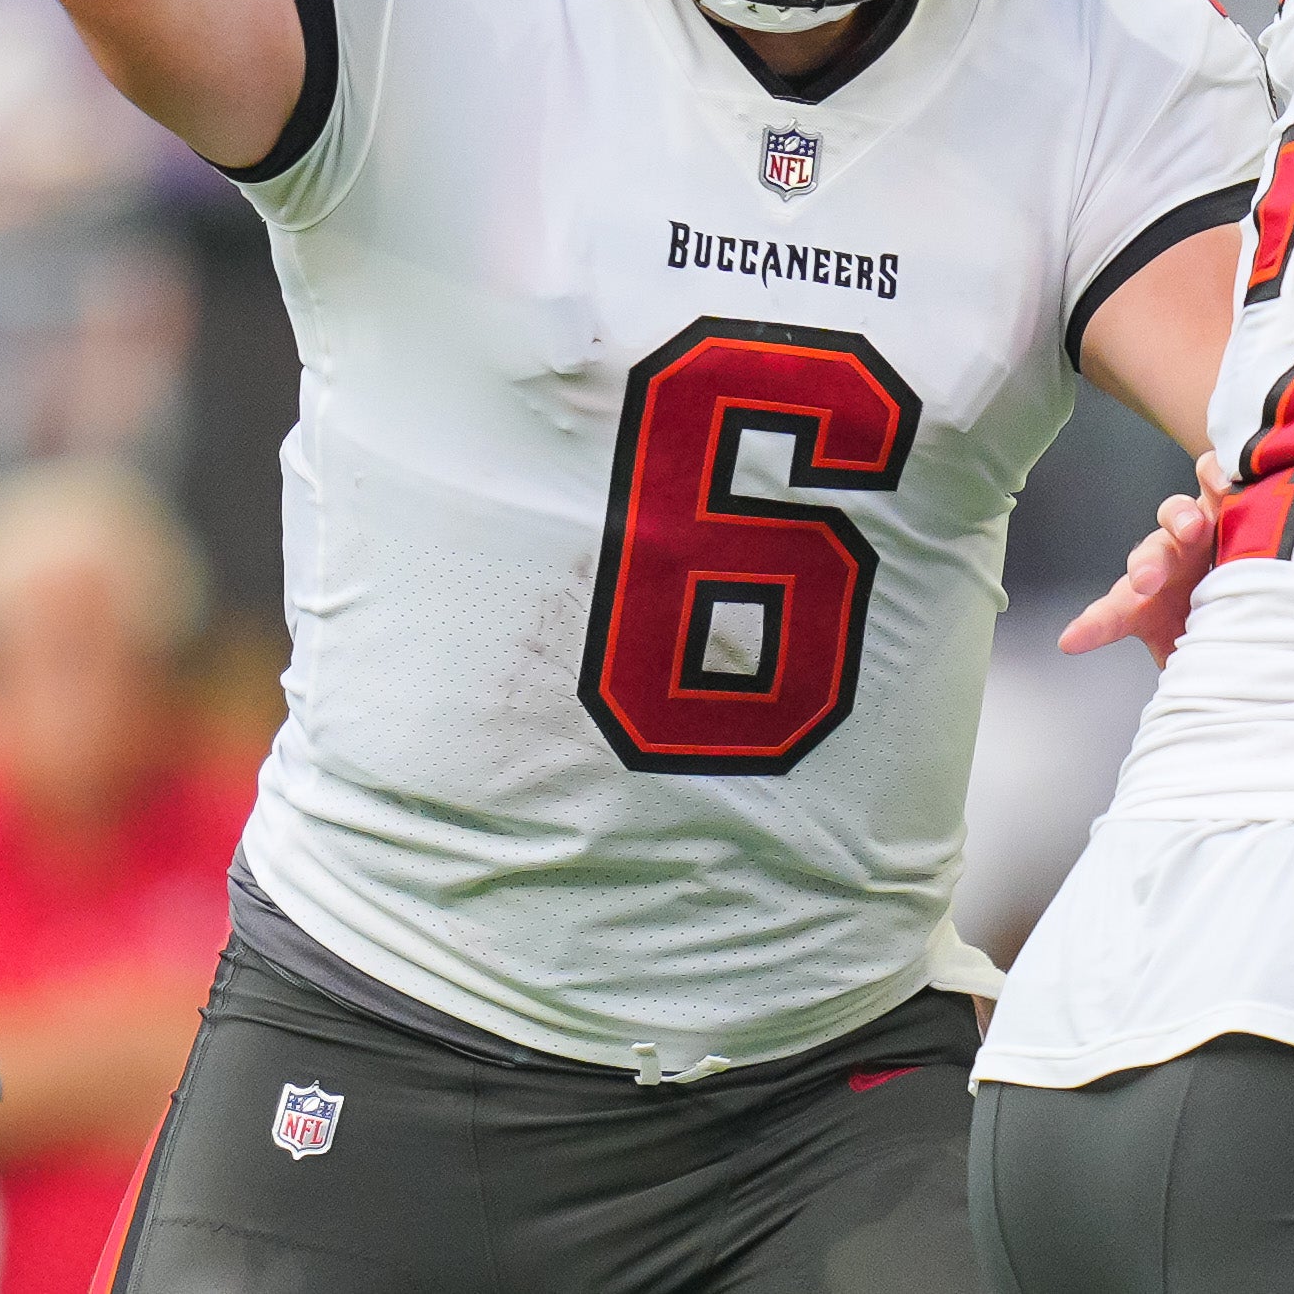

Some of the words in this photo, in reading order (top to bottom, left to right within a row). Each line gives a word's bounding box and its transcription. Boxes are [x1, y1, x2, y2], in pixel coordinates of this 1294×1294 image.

[768, 154, 809, 186] NFL
[667, 220, 899, 300] BUCCANEERS
[576, 314, 924, 776] 6
[283, 1113, 324, 1146] NFL
